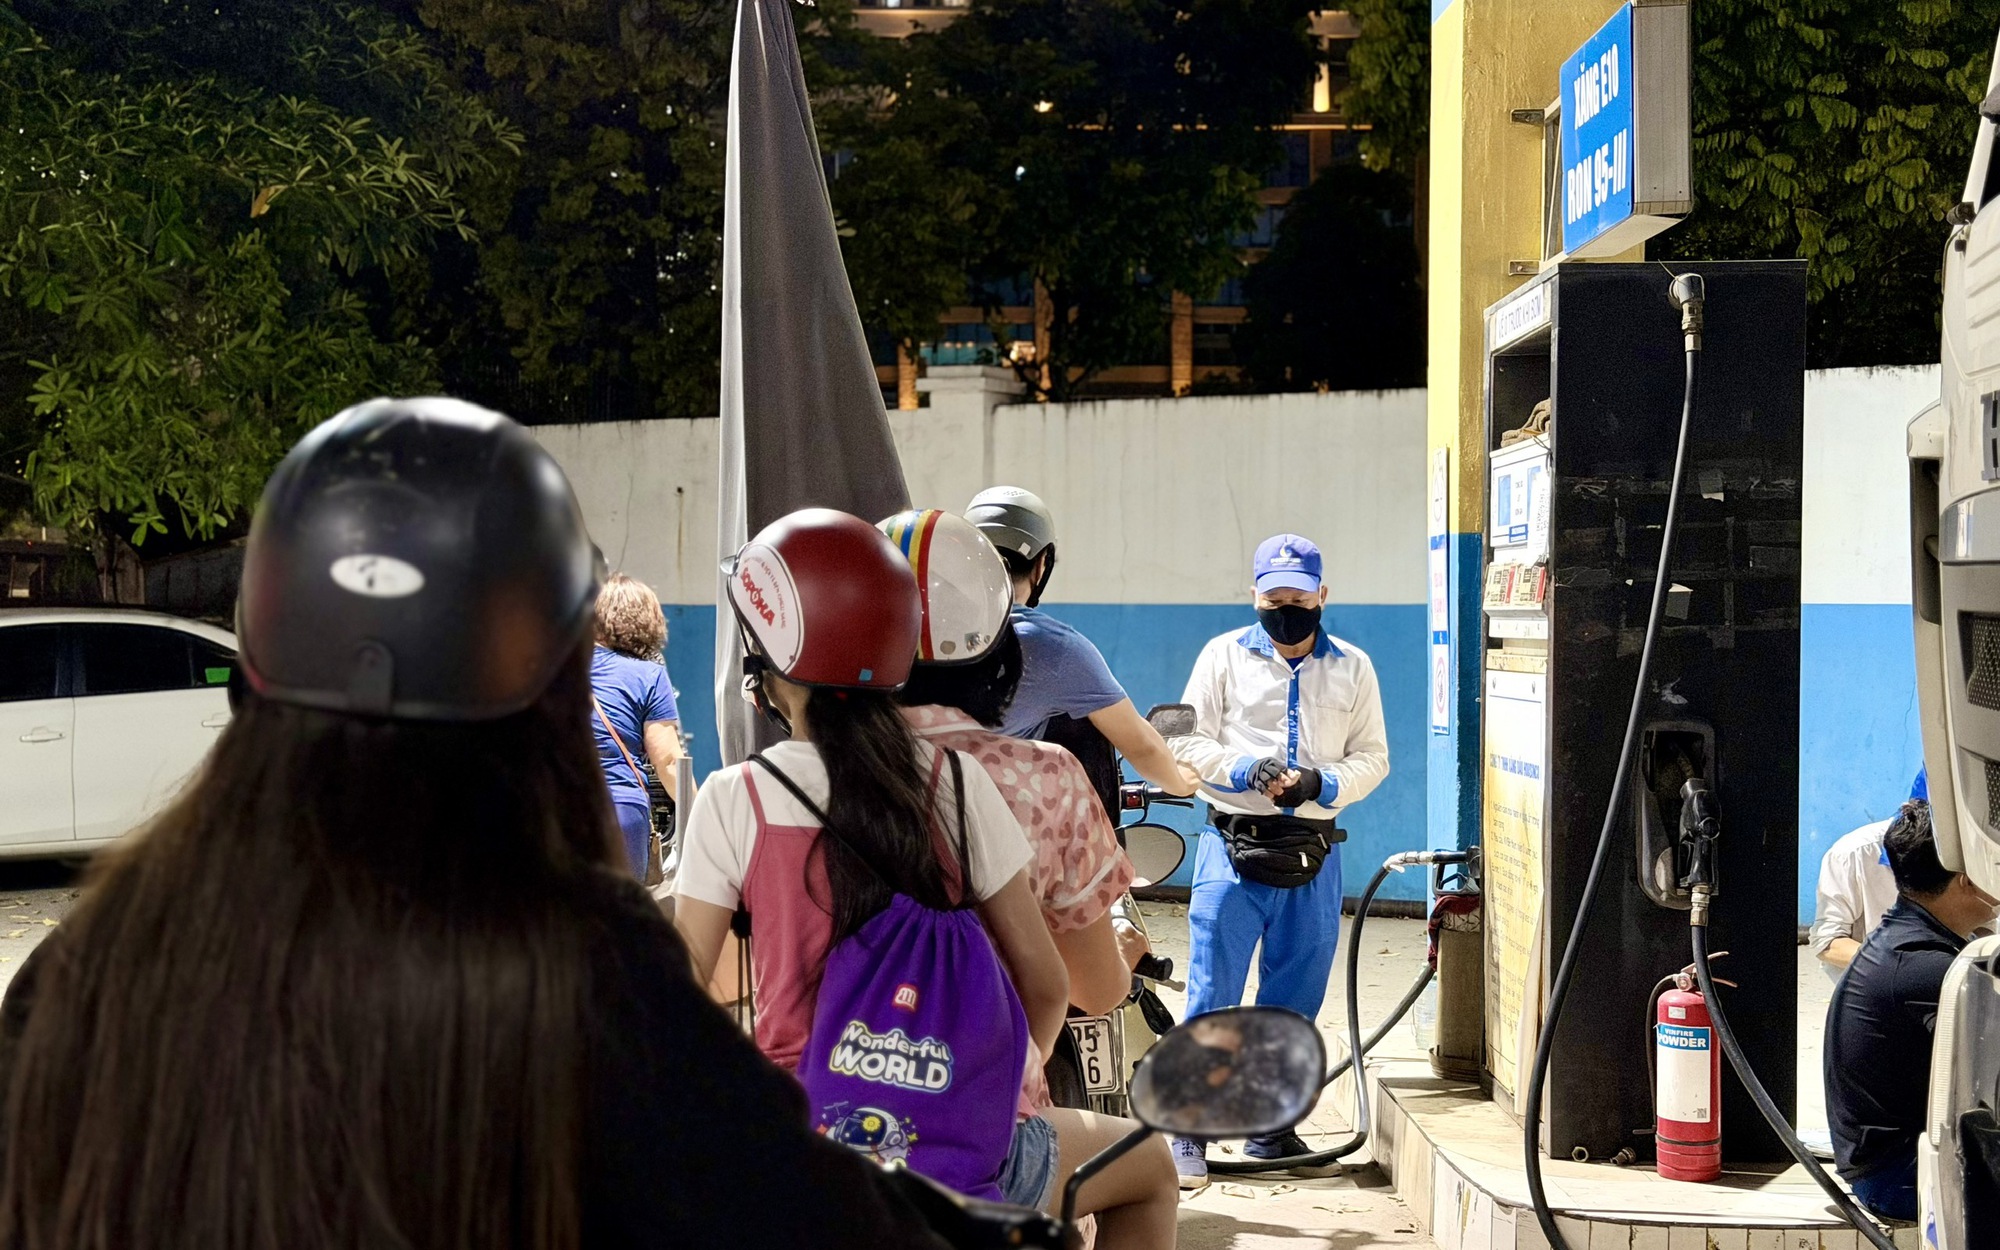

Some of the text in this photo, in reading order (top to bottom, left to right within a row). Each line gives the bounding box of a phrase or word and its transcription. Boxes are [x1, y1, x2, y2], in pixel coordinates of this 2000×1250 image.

[1574, 43, 1619, 130] XĂNG E10
[1567, 128, 1627, 225] RON 95-III
[843, 1024, 949, 1061] Wonderful
[1657, 1034, 1706, 1048] POWDER
[1665, 1028, 1694, 1037] VINFIRE
[832, 1045, 948, 1089] WORLD
